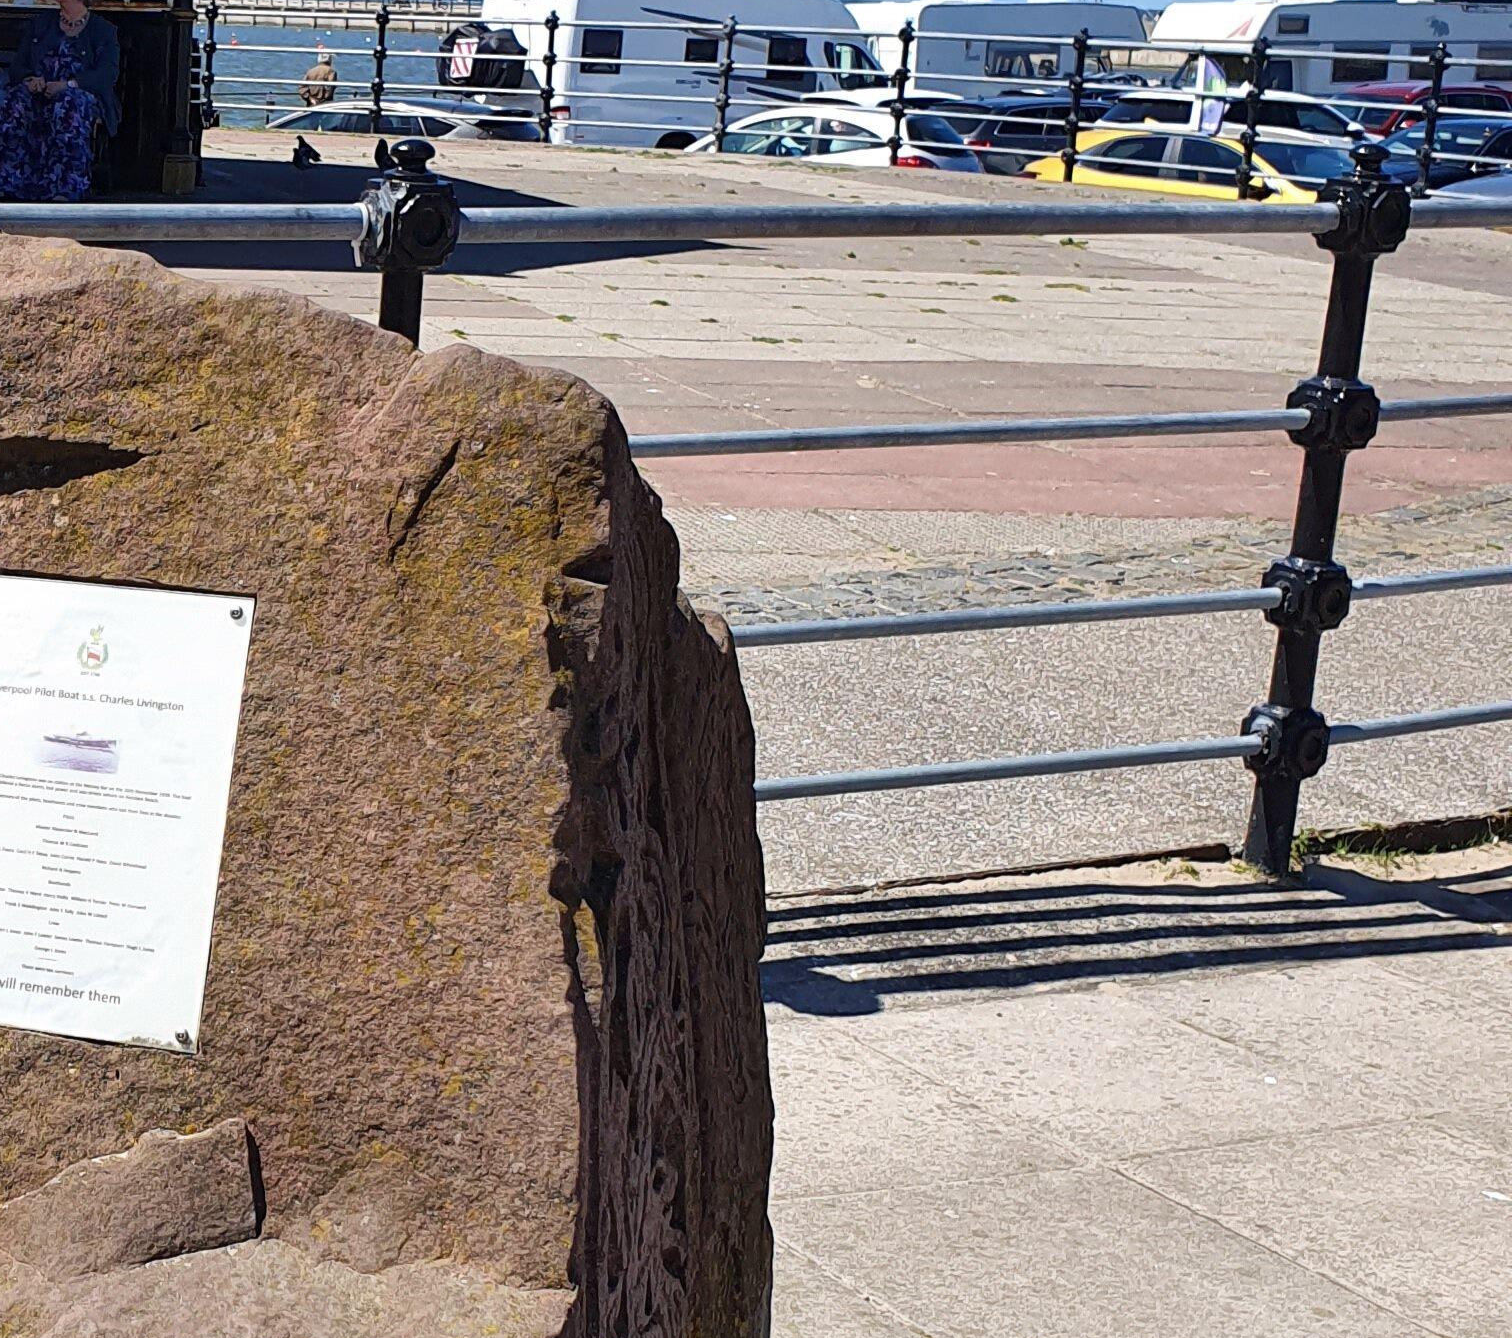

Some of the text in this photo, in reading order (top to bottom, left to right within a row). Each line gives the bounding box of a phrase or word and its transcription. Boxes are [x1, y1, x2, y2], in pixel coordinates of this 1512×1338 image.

[35, 686, 56, 697] Pilot
[58, 689, 80, 700] Boat
[99, 693, 134, 706] Charles
[136, 697, 184, 711] Livingston
[19, 981, 85, 999] remember
[88, 989, 121, 1005] them
